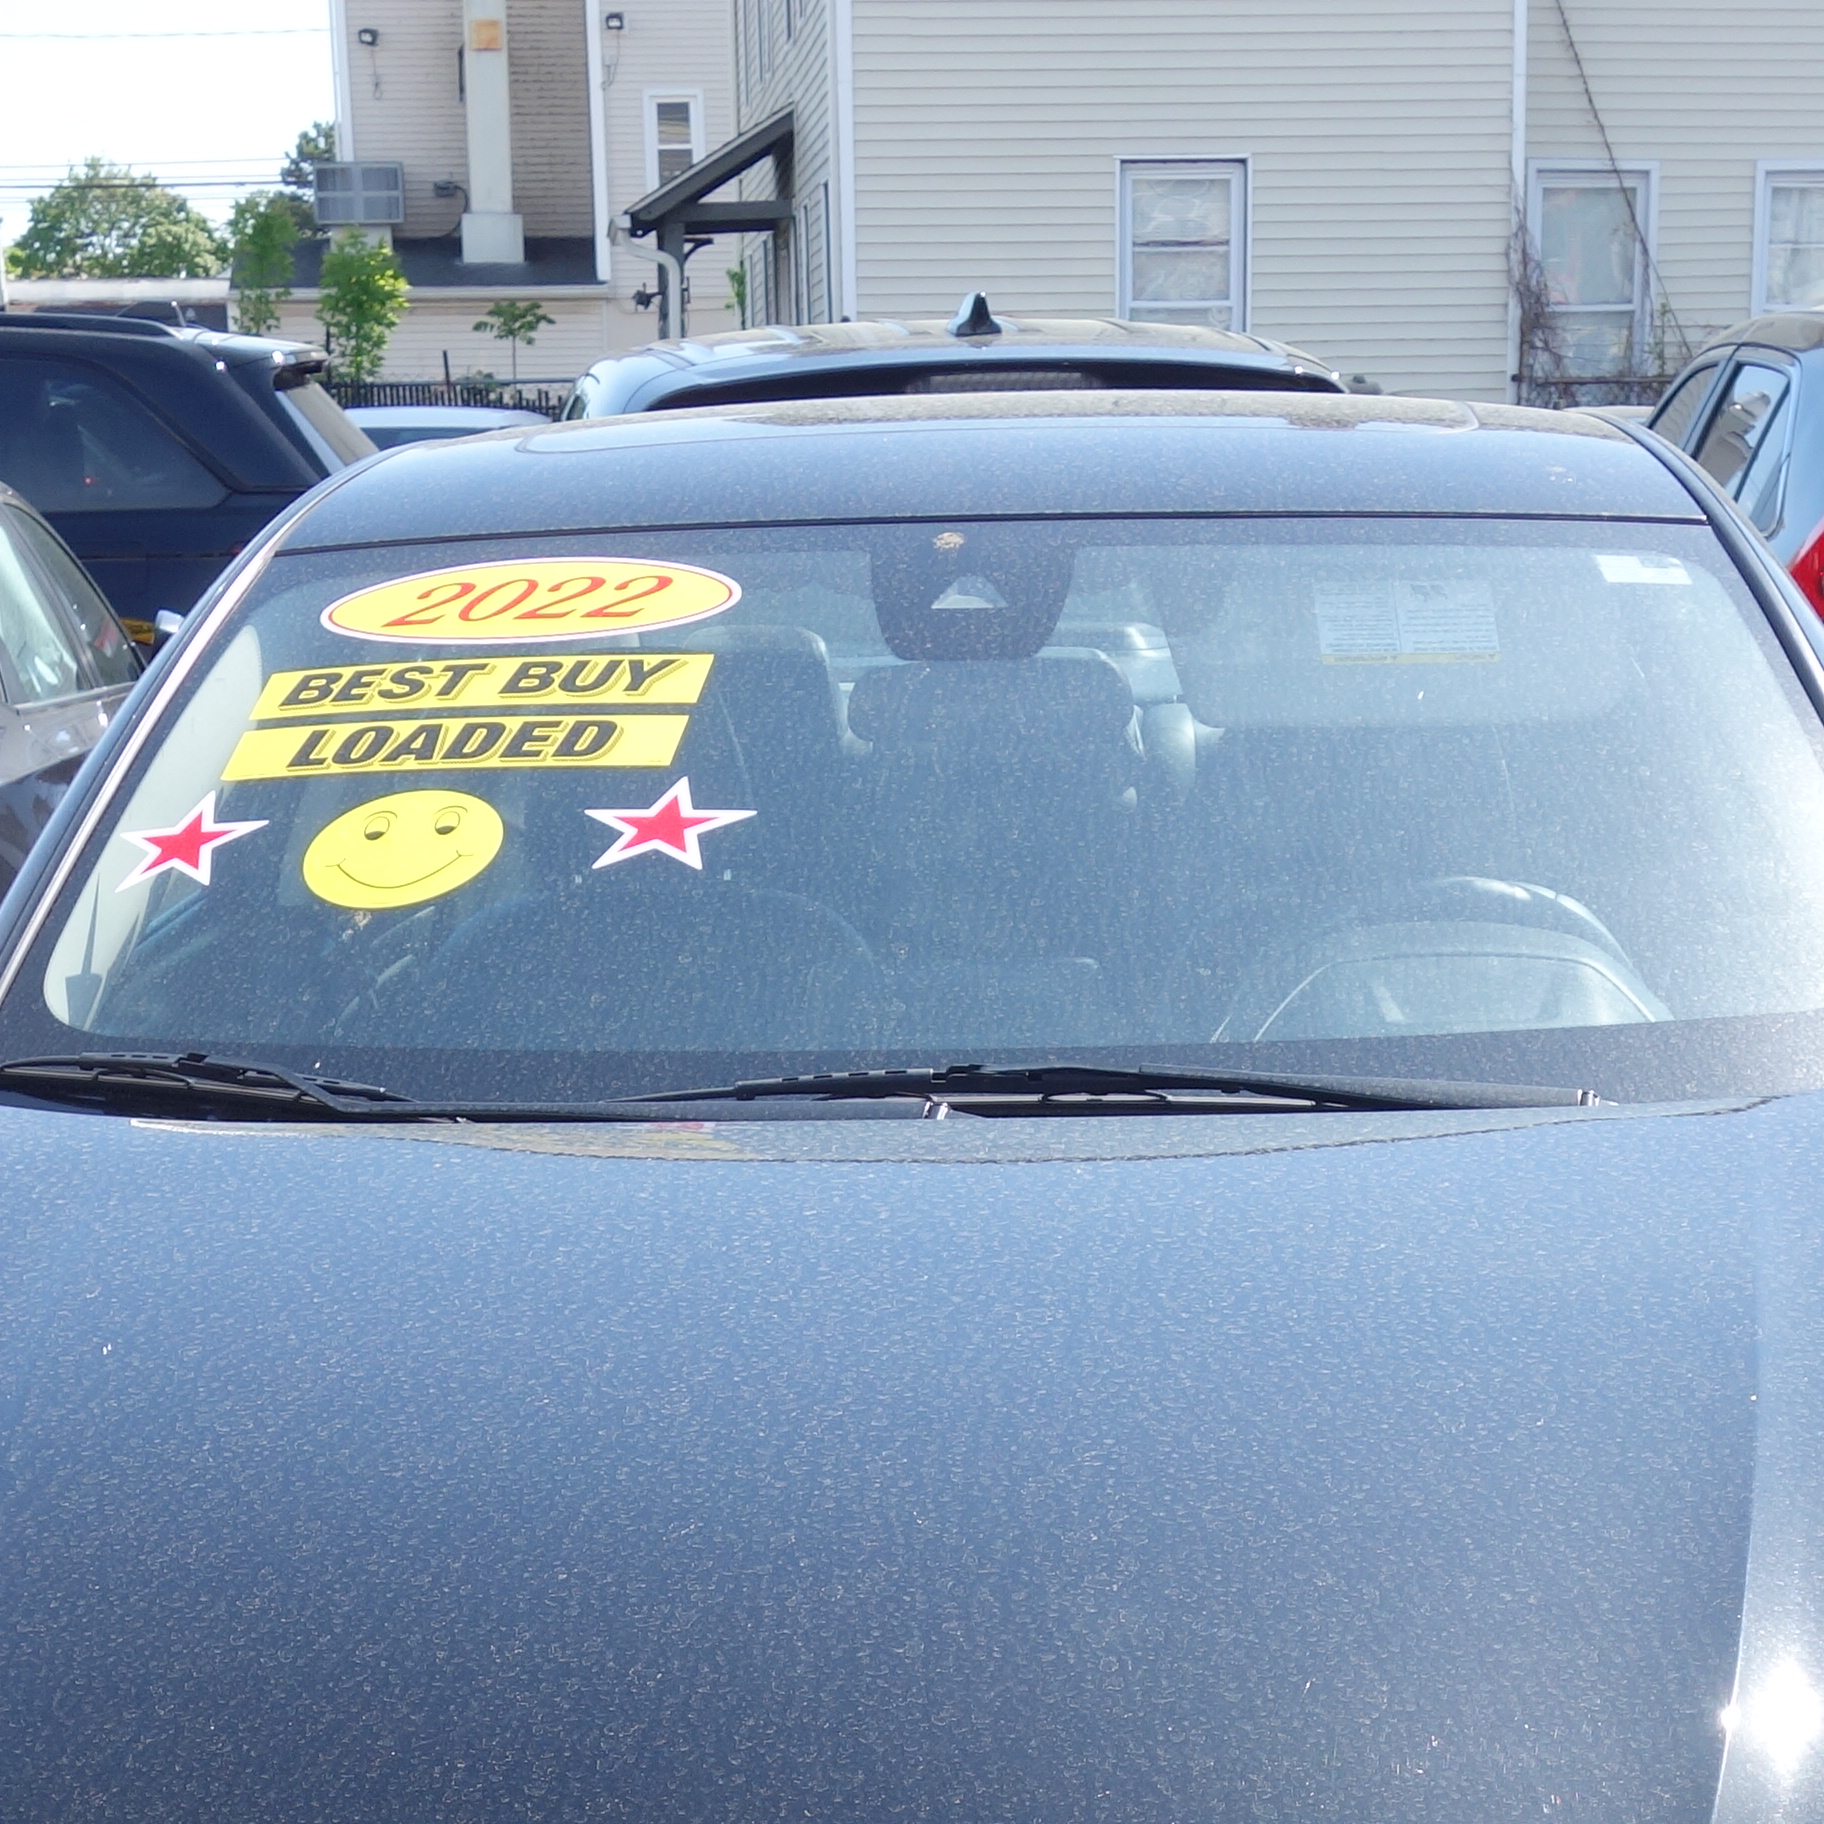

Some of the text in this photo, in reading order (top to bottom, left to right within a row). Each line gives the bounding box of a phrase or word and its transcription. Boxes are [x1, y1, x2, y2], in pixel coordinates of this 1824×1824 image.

[380, 575, 675, 627] 2022
[278, 658, 687, 711] BEST BUY
[285, 720, 624, 772] LOADED
